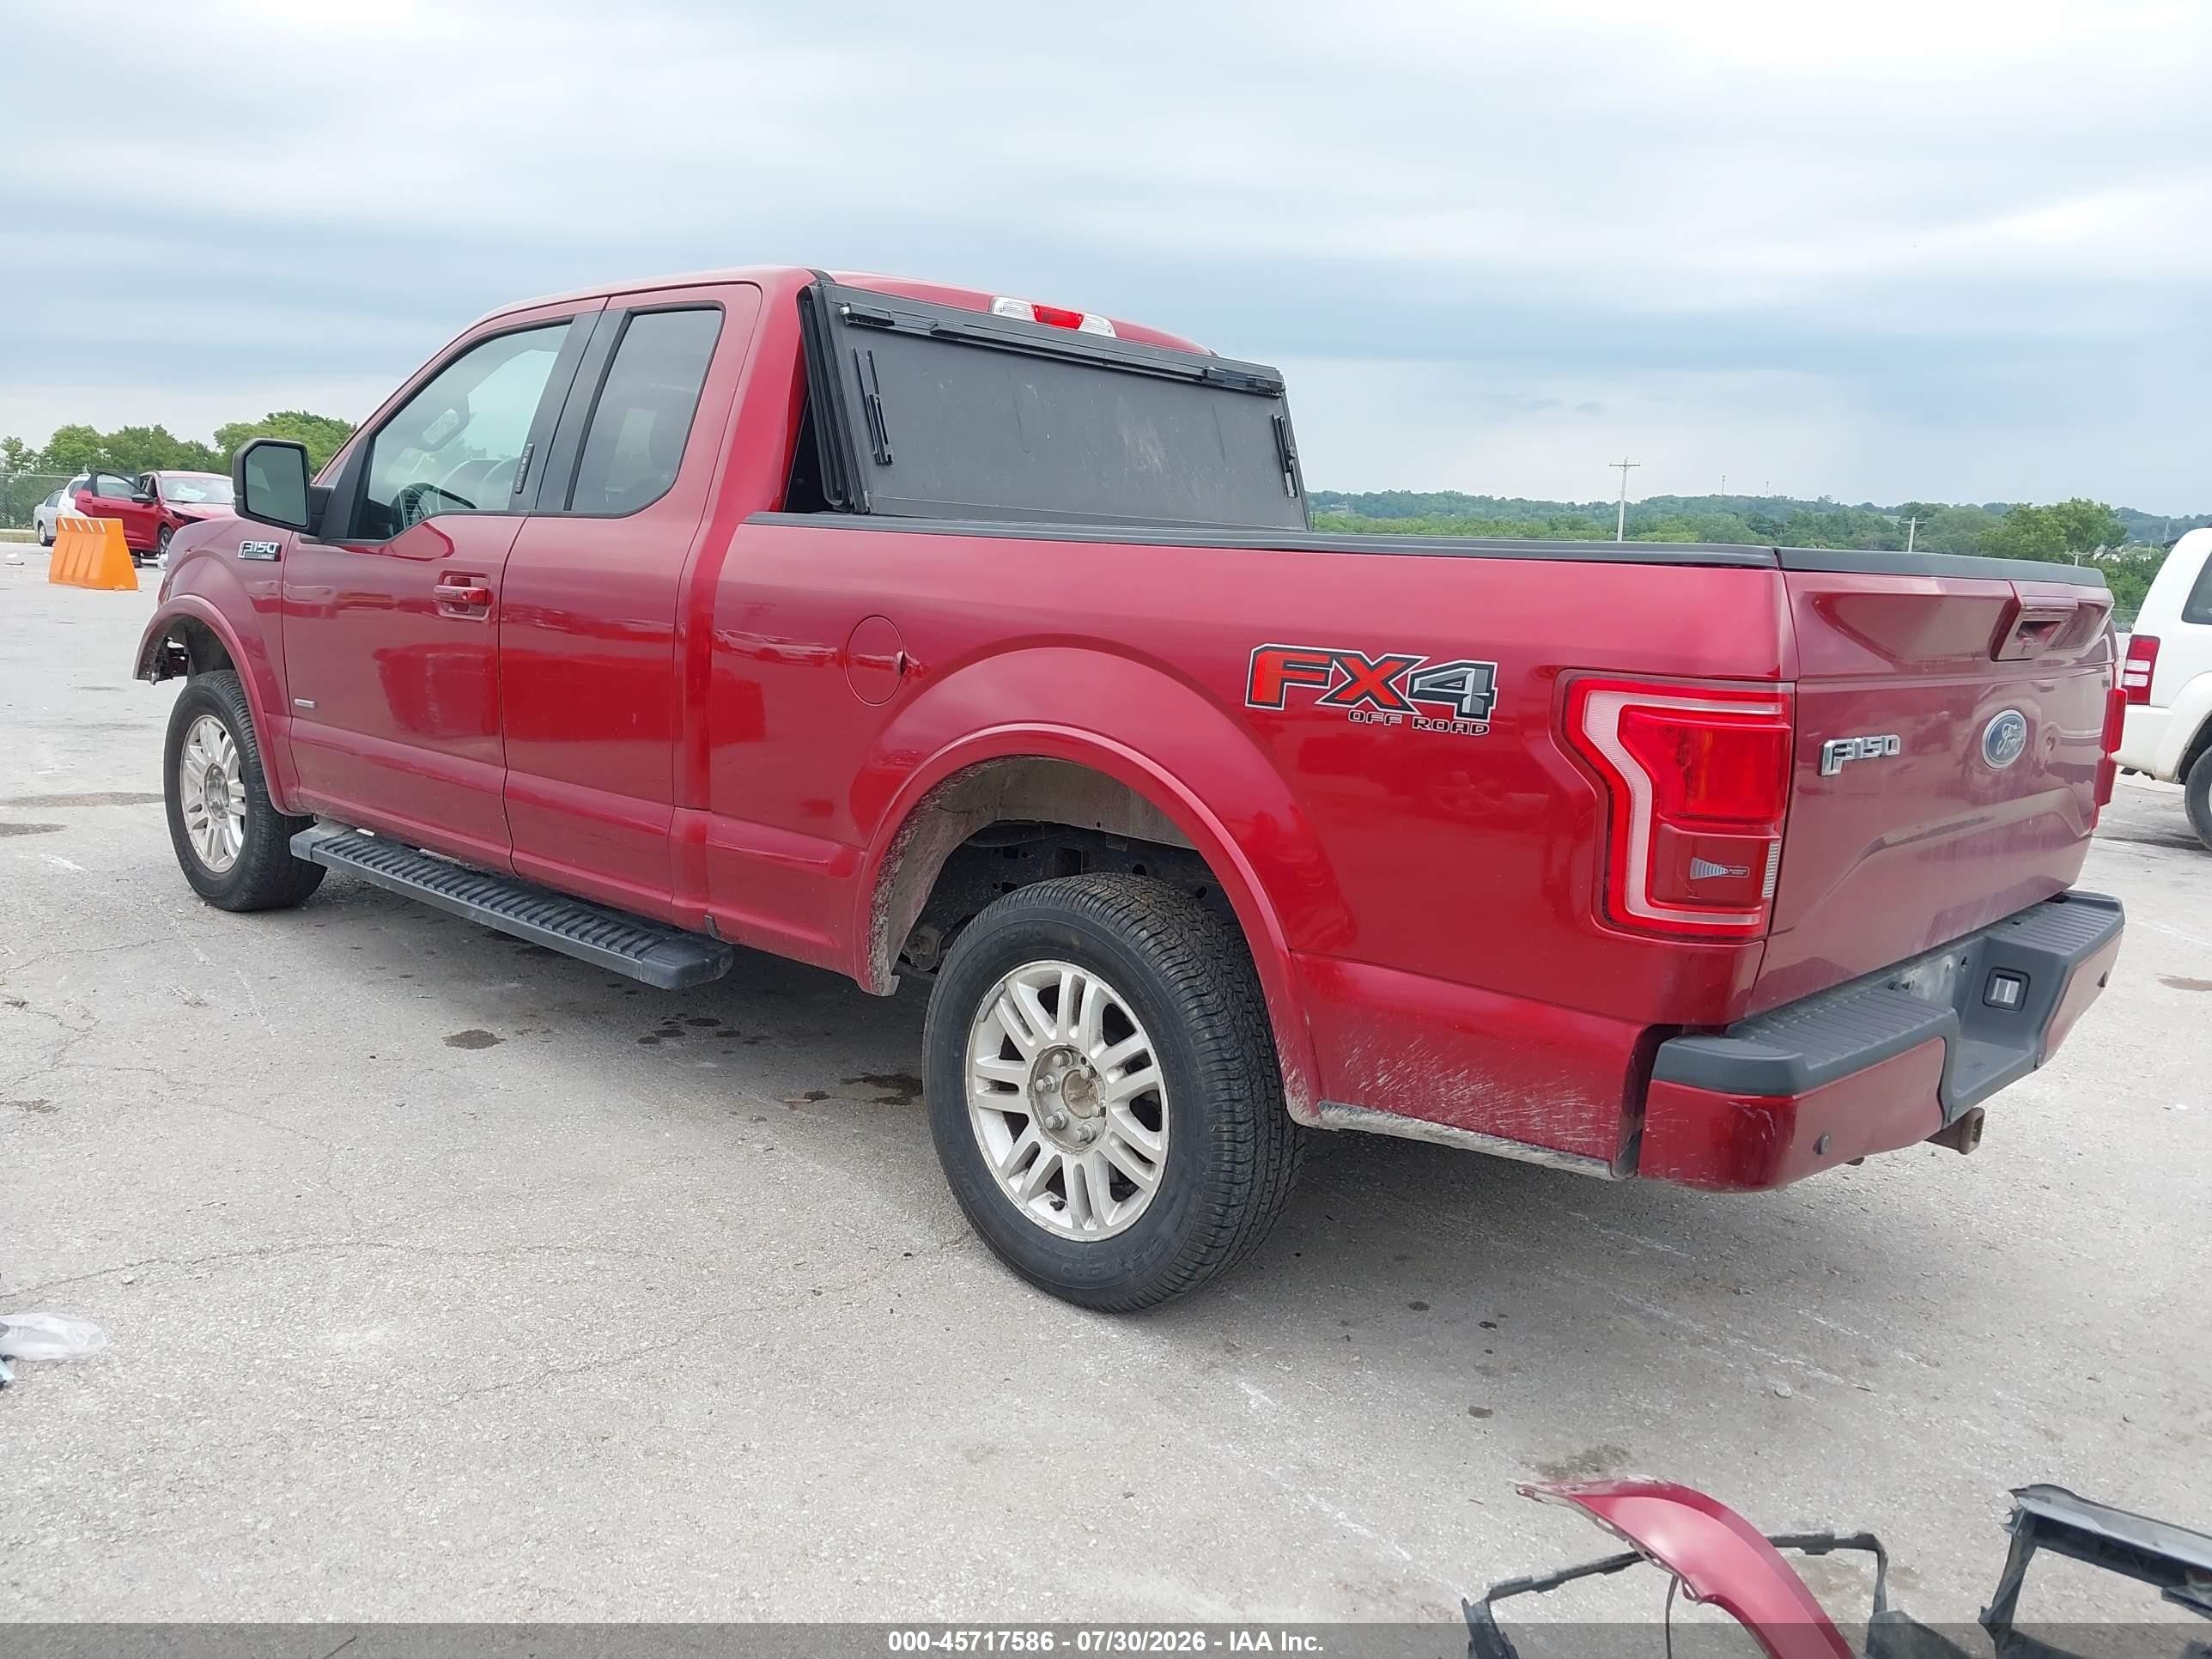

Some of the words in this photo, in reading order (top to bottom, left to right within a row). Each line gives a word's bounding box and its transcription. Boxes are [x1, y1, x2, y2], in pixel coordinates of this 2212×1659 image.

[1245, 642, 1498, 723] FX4
[1348, 709, 1403, 726] OFF
[1412, 720, 1490, 736] ROAD
